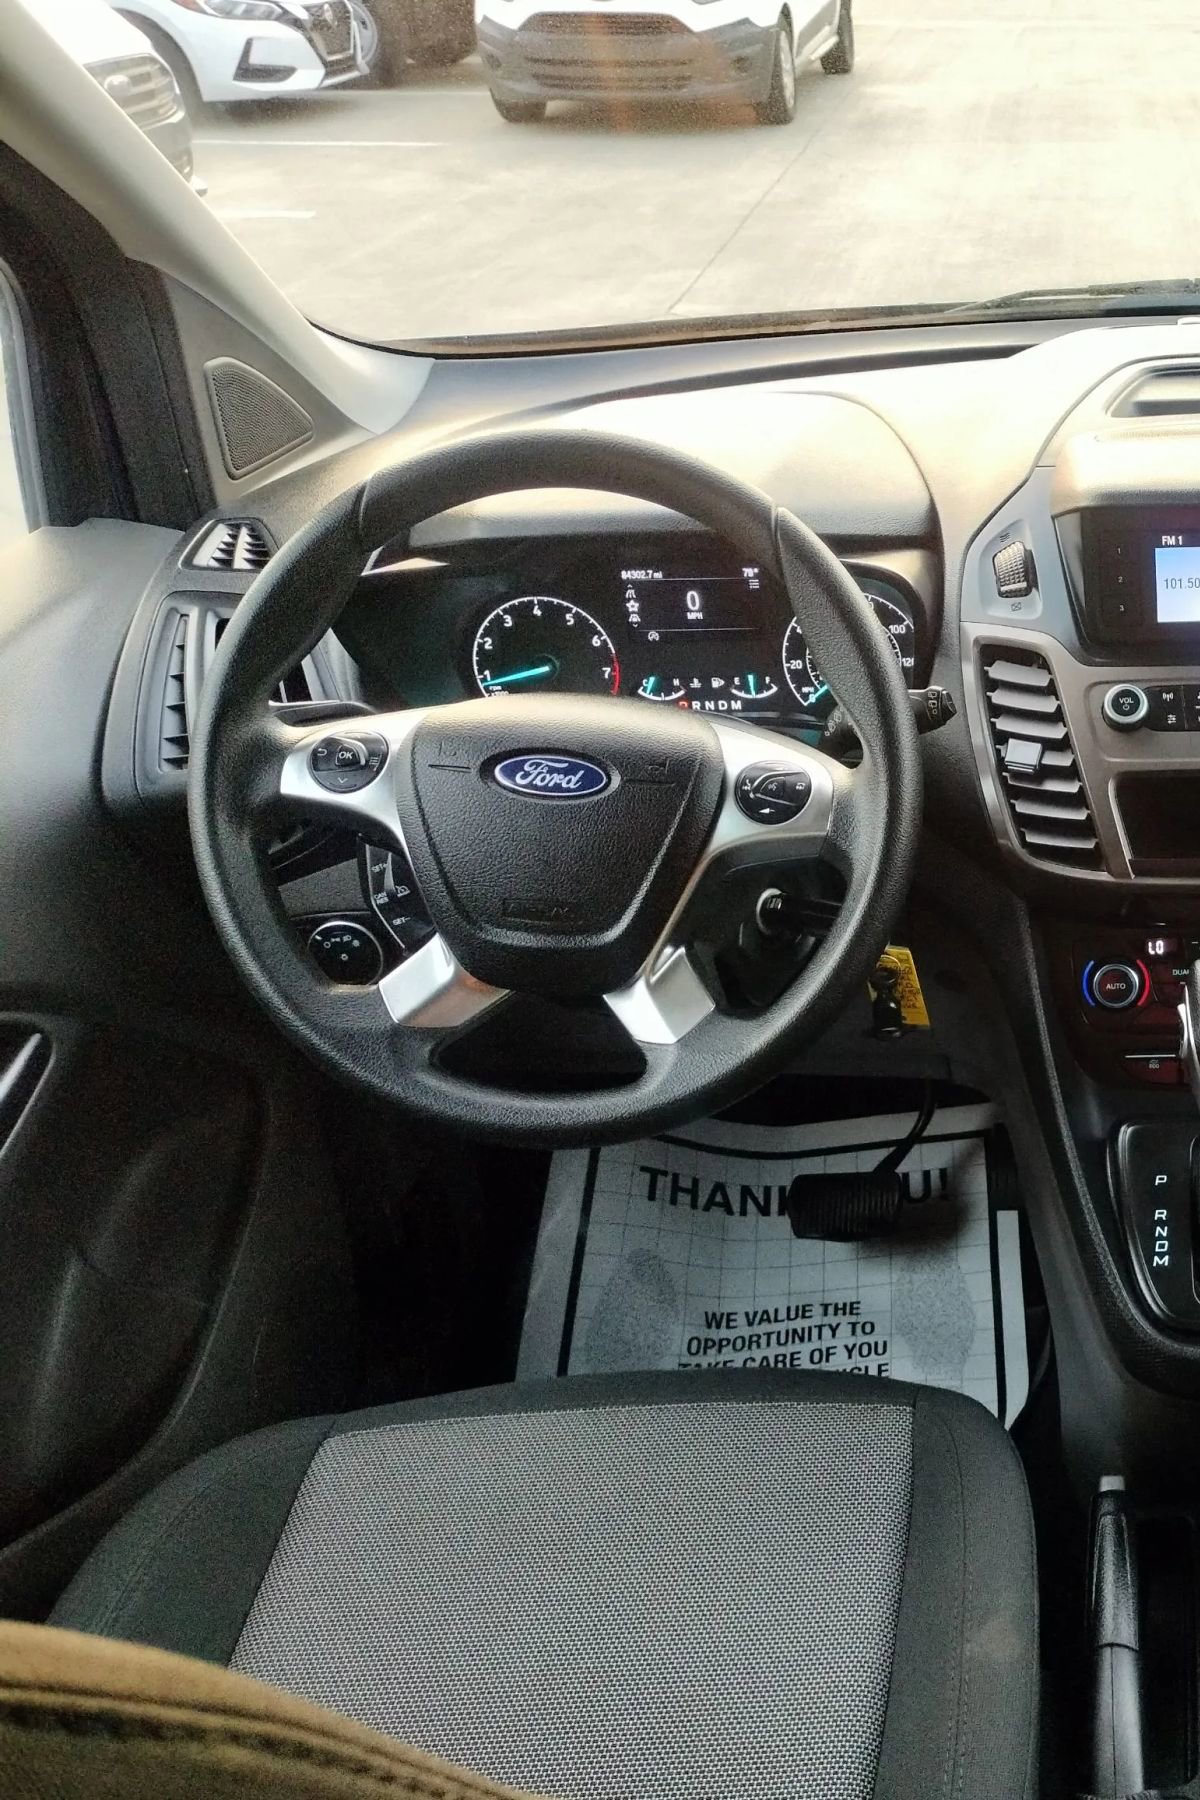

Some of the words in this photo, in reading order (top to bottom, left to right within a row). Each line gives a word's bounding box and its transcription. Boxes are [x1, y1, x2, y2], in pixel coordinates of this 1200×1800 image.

[1162, 535, 1175, 545] FM
[1178, 535, 1183, 544] 1
[1163, 577, 1200, 589] 101.50
[686, 591, 700, 611] 0
[533, 605, 542, 616] 4
[687, 612, 703, 620] MPH
[503, 615, 513, 627] 3
[565, 614, 575, 626] 5
[889, 624, 906, 634] 100
[483, 637, 493, 649] 2
[592, 635, 601, 647] 6
[789, 660, 803, 670] 20
[483, 669, 491, 681] 1
[602, 667, 611, 679] 7
[691, 701, 701, 710] R
[705, 701, 714, 710] N
[718, 701, 728, 710] D
[731, 701, 742, 710] M
[338, 751, 354, 759] OK
[515, 759, 585, 788] Ford
[1155, 1175, 1167, 1186] P
[1154, 1209, 1167, 1220] R
[1155, 1226, 1168, 1237] N
[1155, 1240, 1168, 1252] D
[1153, 1255, 1169, 1267] M
[705, 1311, 738, 1330] WE
[744, 1303, 813, 1327] VALUE
[819, 1301, 861, 1317] THE
[687, 1322, 841, 1356] OPPORTUNITY
[848, 1321, 875, 1337] TO
[810, 1345, 837, 1365] OF
[844, 1340, 887, 1360] YOU
